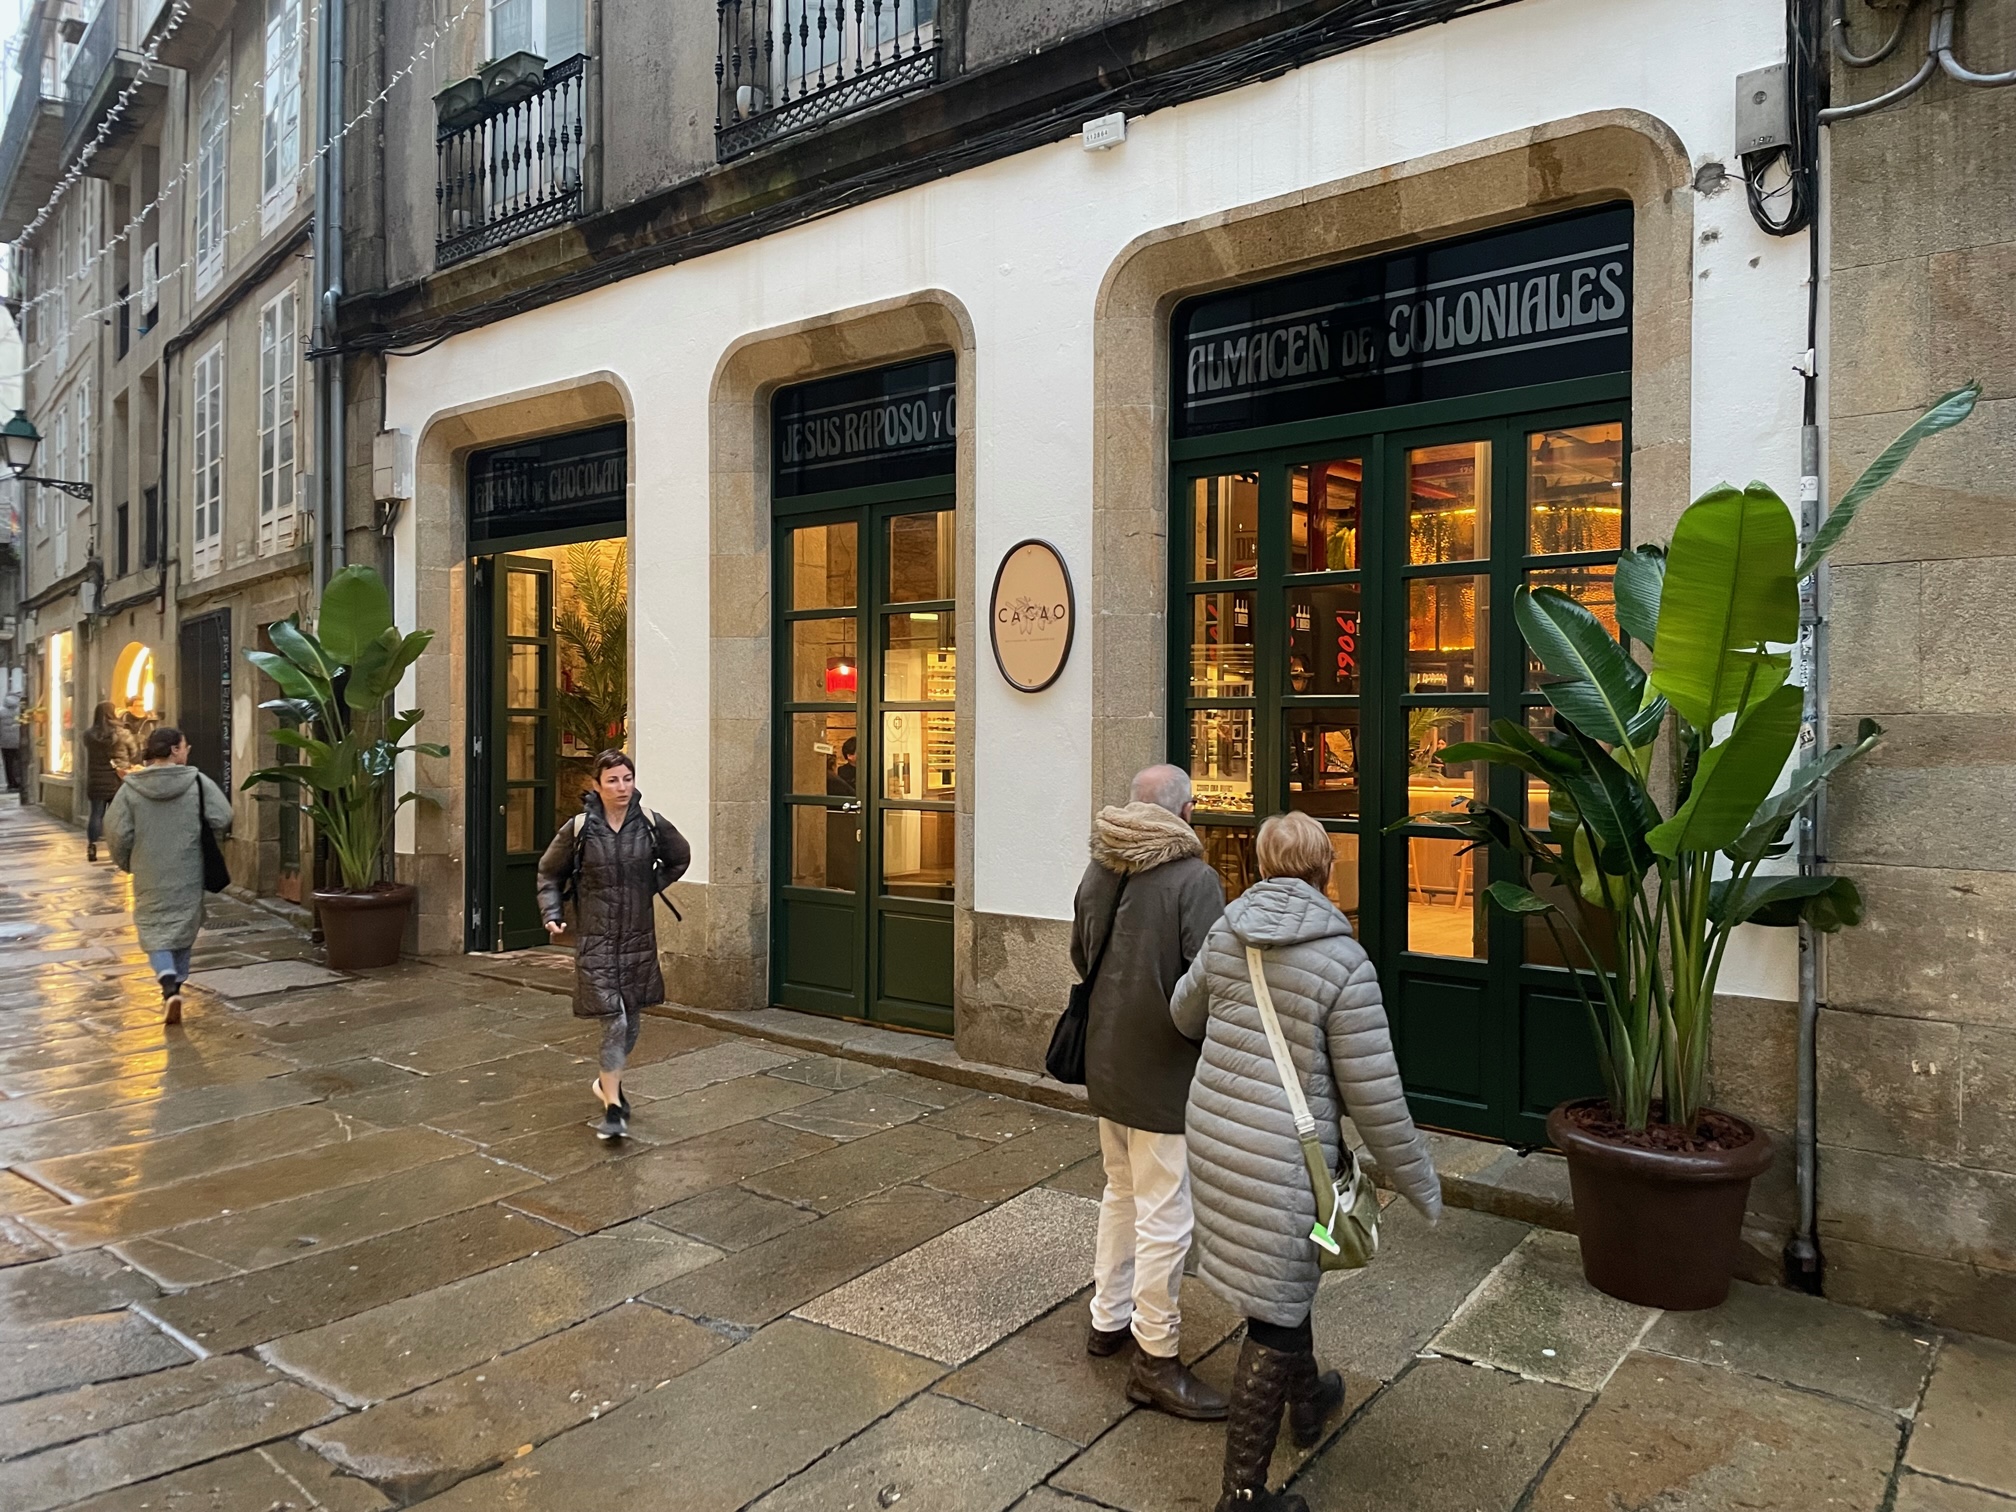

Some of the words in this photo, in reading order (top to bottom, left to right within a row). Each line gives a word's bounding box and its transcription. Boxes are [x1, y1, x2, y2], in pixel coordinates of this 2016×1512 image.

[1187, 322, 1329, 395] ALMACEN
[1342, 326, 1374, 366] DE
[1388, 261, 1625, 358] COLONIALES
[781, 416, 842, 464] JESUS
[845, 400, 928, 453] RAPOSO
[998, 603, 1066, 623] CACAO
